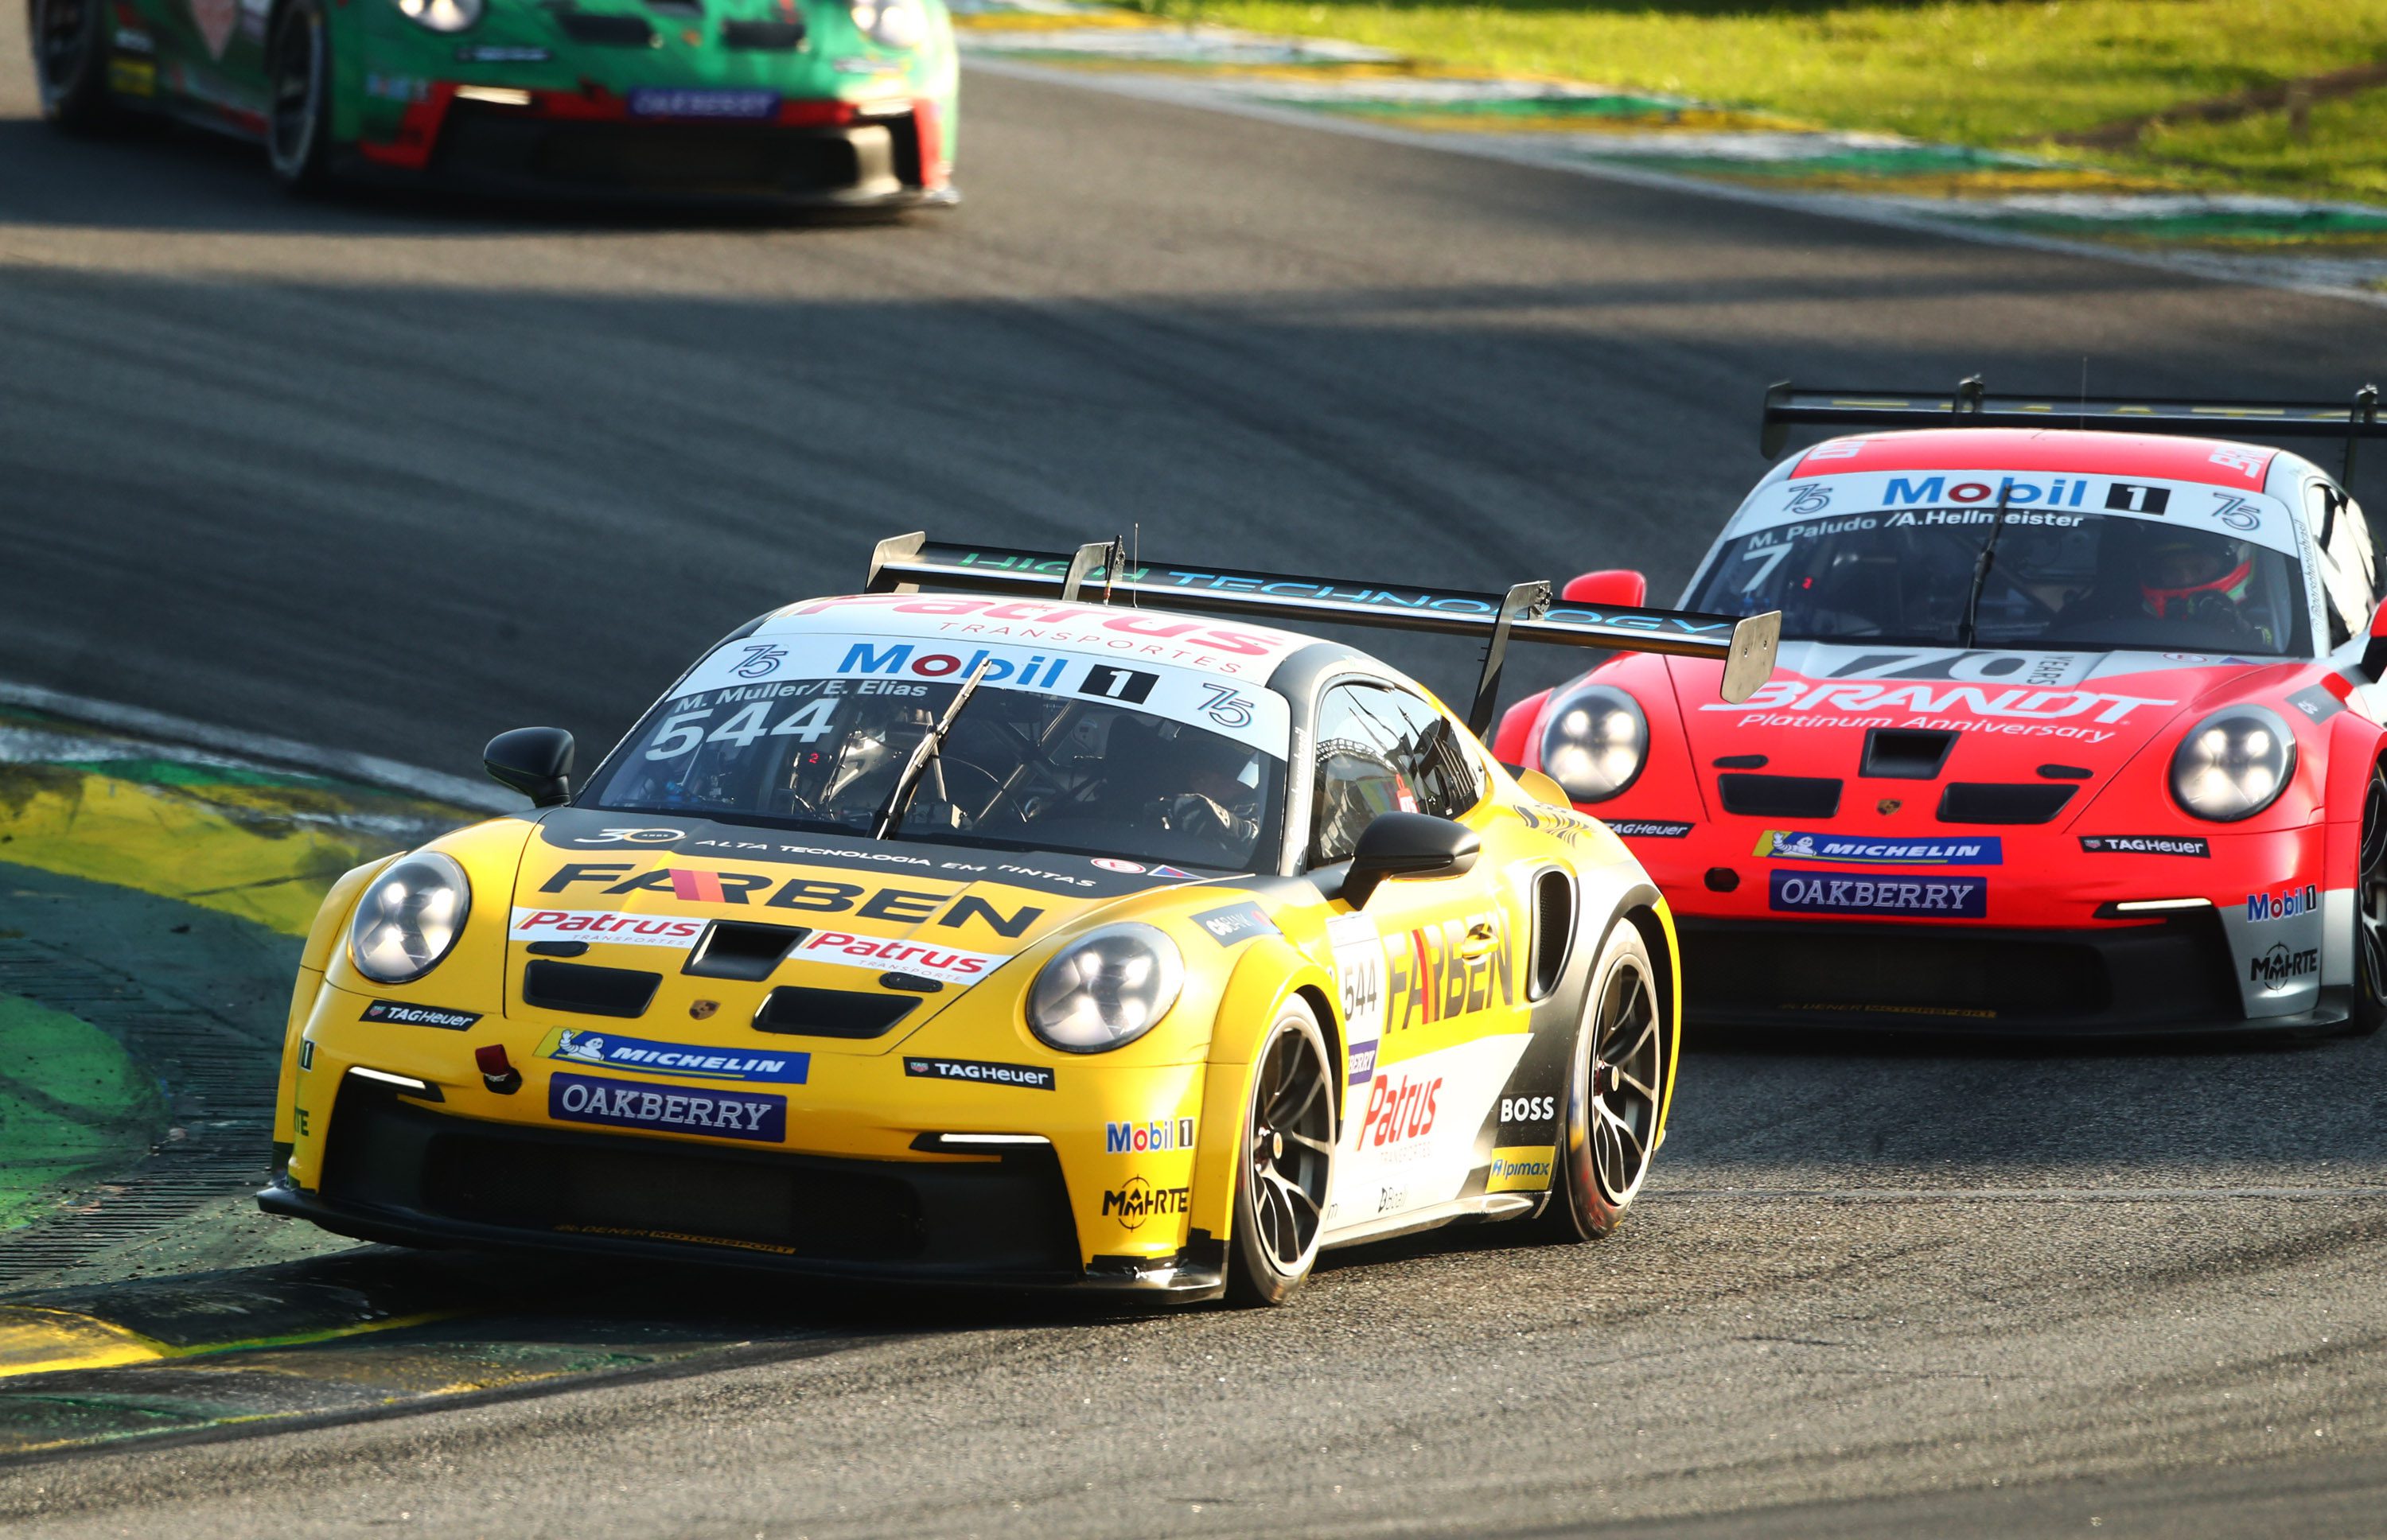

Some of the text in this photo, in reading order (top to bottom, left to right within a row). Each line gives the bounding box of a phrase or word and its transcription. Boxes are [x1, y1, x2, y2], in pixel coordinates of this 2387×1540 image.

[1882, 476, 2088, 508] Mobil
[1749, 531, 1778, 550] M.
[1787, 516, 1877, 542] Paludo
[1743, 542, 1794, 594] 7
[1168, 571, 1731, 634] TECHNOOGY
[836, 643, 1069, 690] Mobil
[939, 622, 1243, 675] TRANSPORTES
[2026, 655, 2075, 686] YEARS
[675, 698, 703, 714] M.
[858, 680, 929, 698] Elias
[1698, 681, 2179, 725] BRANDT
[644, 698, 841, 761] 544
[1738, 712, 2116, 743] Platinum Anniversary
[695, 839, 1096, 888] ALTA TECNOLOGIA EM TINTAS
[1822, 842, 1981, 858] MICHELIN
[538, 862, 1045, 939] FARBEN
[1781, 878, 1974, 910] OAKBERRY
[2248, 888, 2303, 921] Mobil
[520, 911, 702, 937] Patrus
[572, 934, 686, 947] TRANSPORTES
[806, 931, 988, 974] Patrus
[1383, 908, 1513, 1034] FARBEN
[1345, 958, 1377, 1022] 544
[610, 1046, 786, 1073] MICHELIN
[562, 1083, 773, 1131] OAKBERRY
[1357, 1074, 1443, 1152] Patrus
[1500, 1096, 1555, 1123] BOSS
[1107, 1121, 1174, 1153] Mobil
